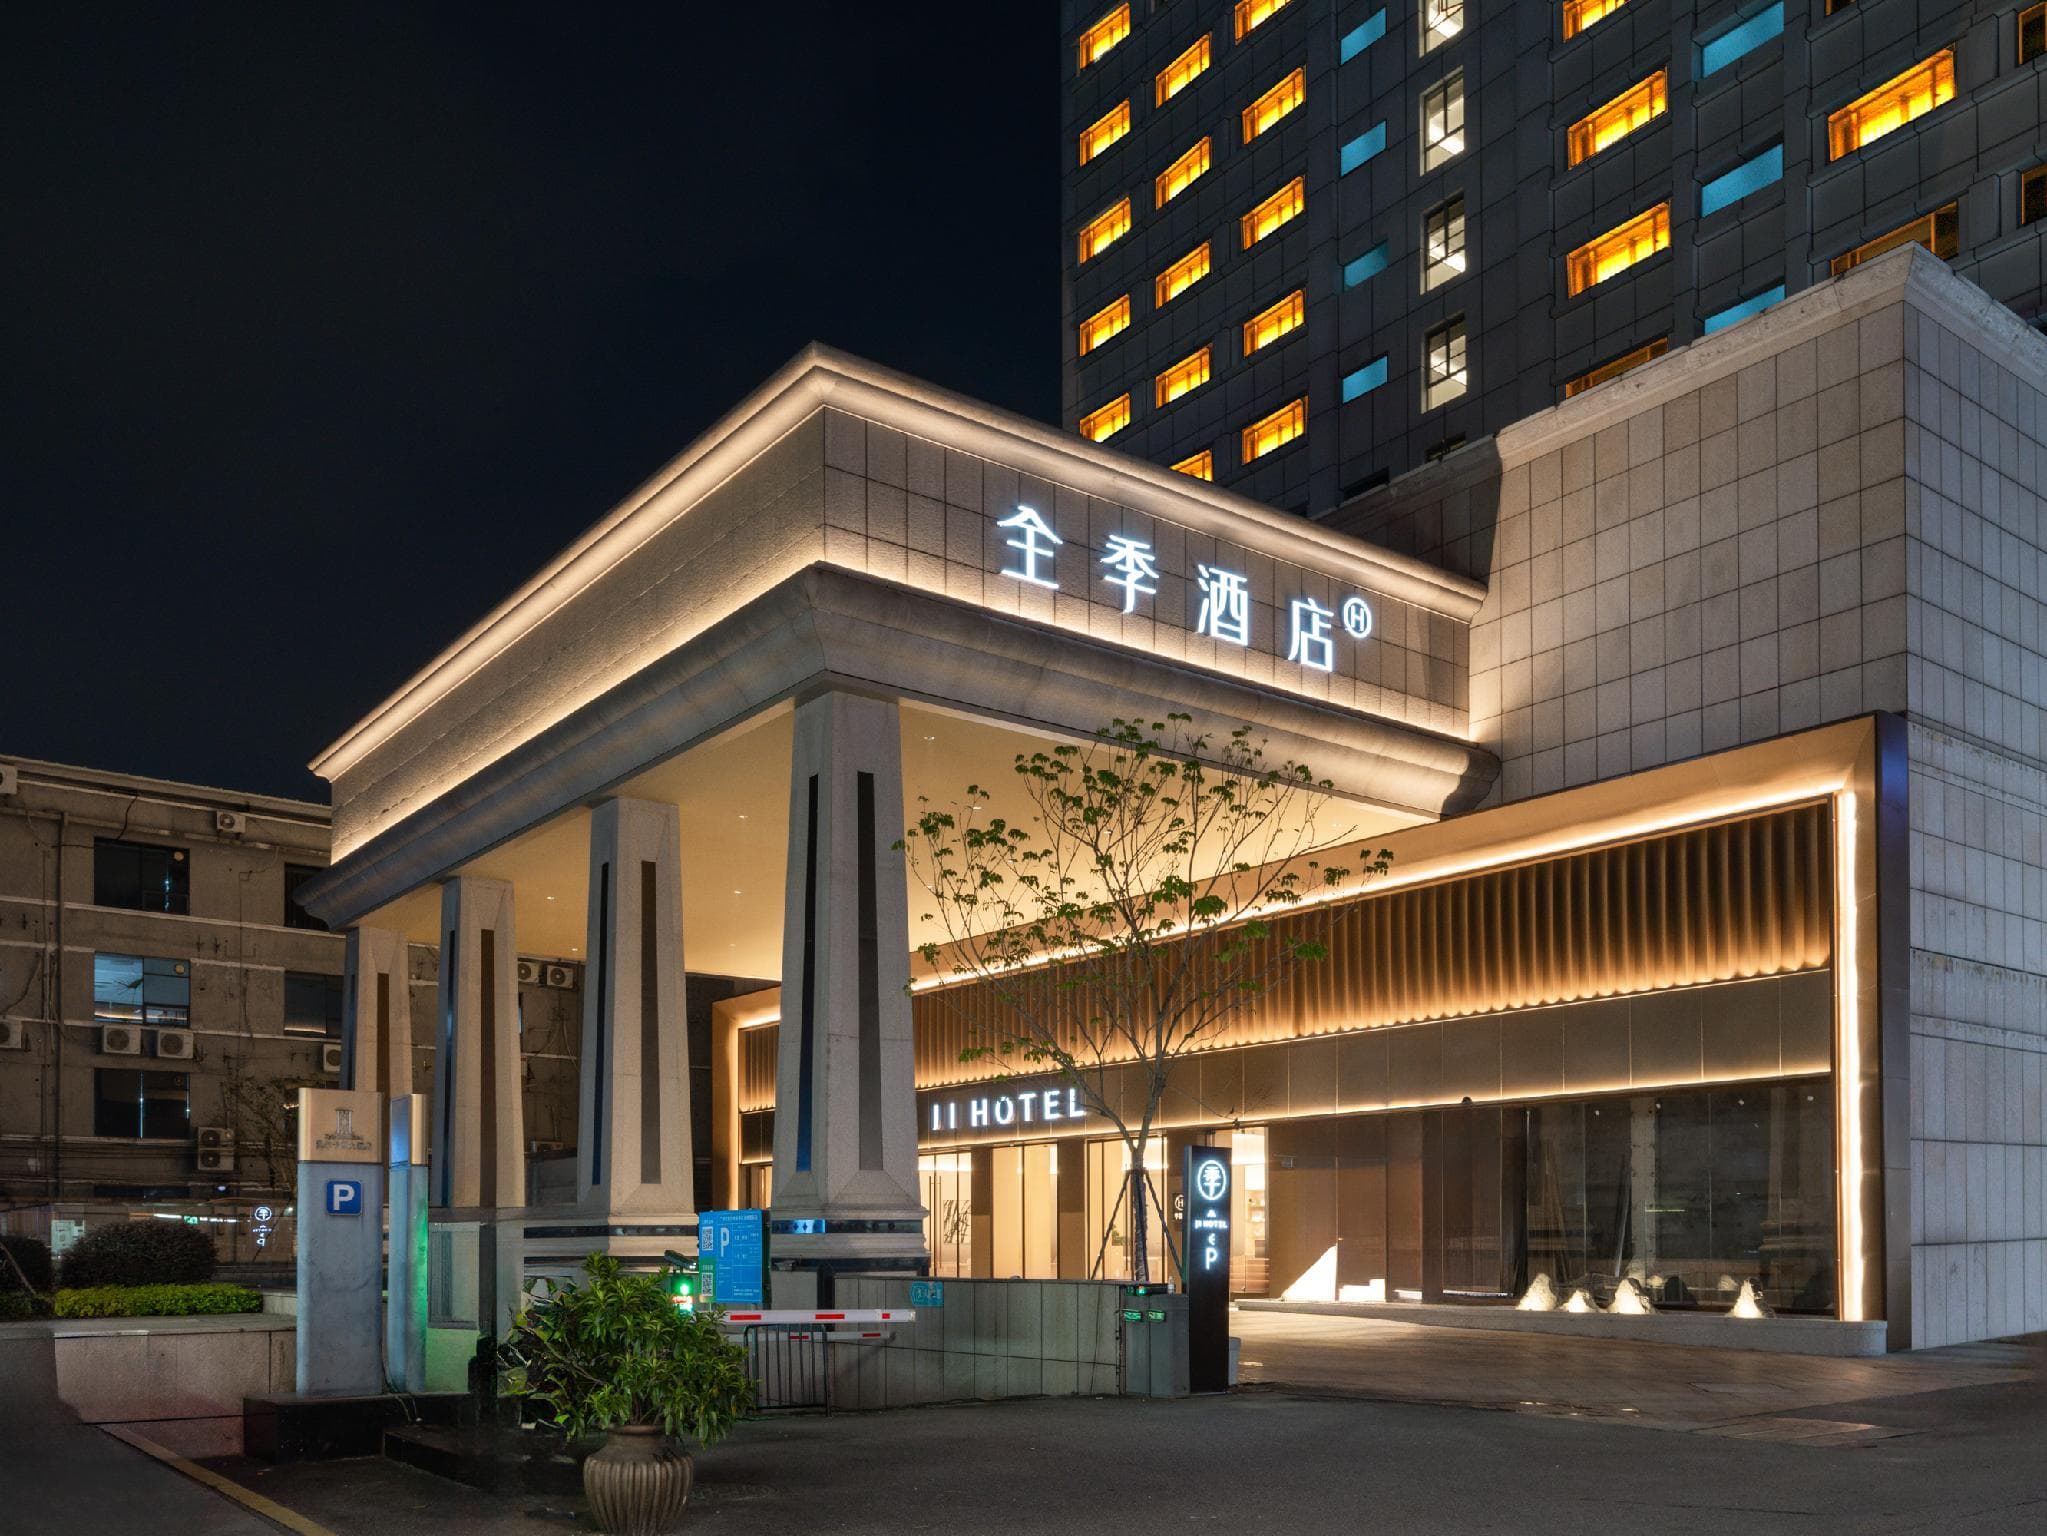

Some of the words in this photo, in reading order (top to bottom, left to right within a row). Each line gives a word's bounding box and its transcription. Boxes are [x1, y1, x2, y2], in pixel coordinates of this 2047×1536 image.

[997, 505, 1334, 672] 全季酒店
[970, 1088, 1087, 1127] HOTEL
[333, 1184, 355, 1210] P
[720, 1227, 730, 1257] P
[1205, 1247, 1218, 1270] P
